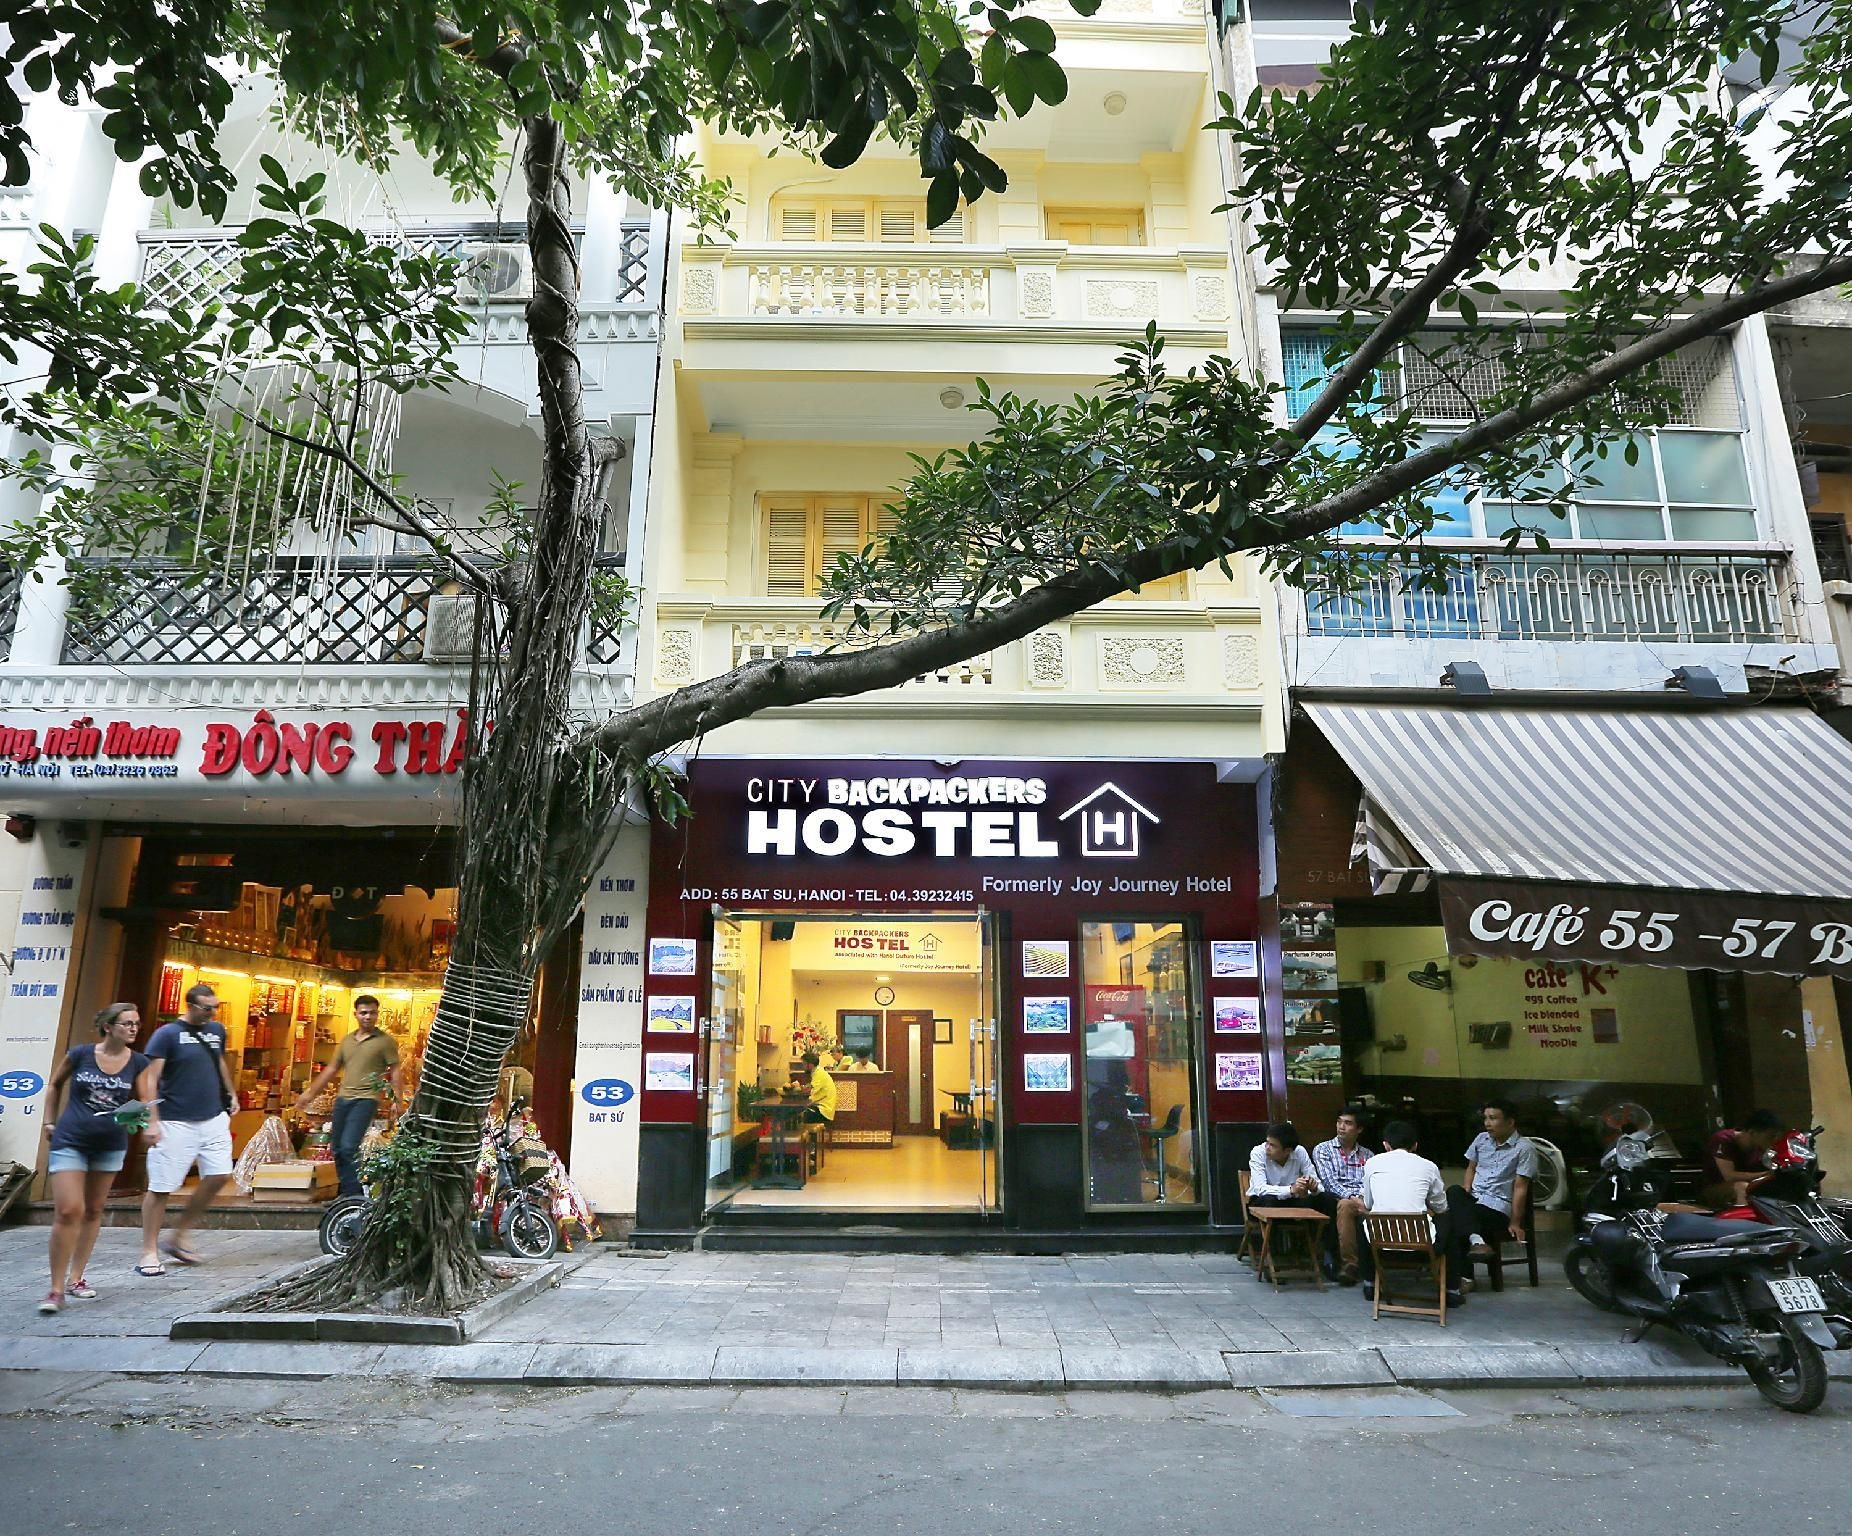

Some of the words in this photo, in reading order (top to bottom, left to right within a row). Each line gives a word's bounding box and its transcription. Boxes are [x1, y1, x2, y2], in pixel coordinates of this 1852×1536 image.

[199, 708, 354, 775] ĐÔNG
[747, 778, 816, 802] CITY
[827, 777, 1047, 806] BACKPACKERS
[747, 808, 1058, 856] HOSTEL
[982, 876, 1063, 896] Formerly
[1070, 876, 1103, 896] Joy
[1108, 876, 1179, 896] Journey
[1186, 876, 1232, 892] Hotel
[742, 889, 769, 901] BAT
[1469, 900, 1590, 951] Café
[1600, 910, 1679, 953] 55
[1310, 951, 1334, 959] Pagoda
[1546, 995, 1578, 1004] Coffee
[1540, 1010, 1580, 1019] blended
[1528, 1024, 1549, 1034] Milk
[1552, 1024, 1582, 1033] Shake
[2, 1078, 34, 1091] 53
[591, 1086, 625, 1100] 53
[1783, 1295, 1820, 1311] 5678
